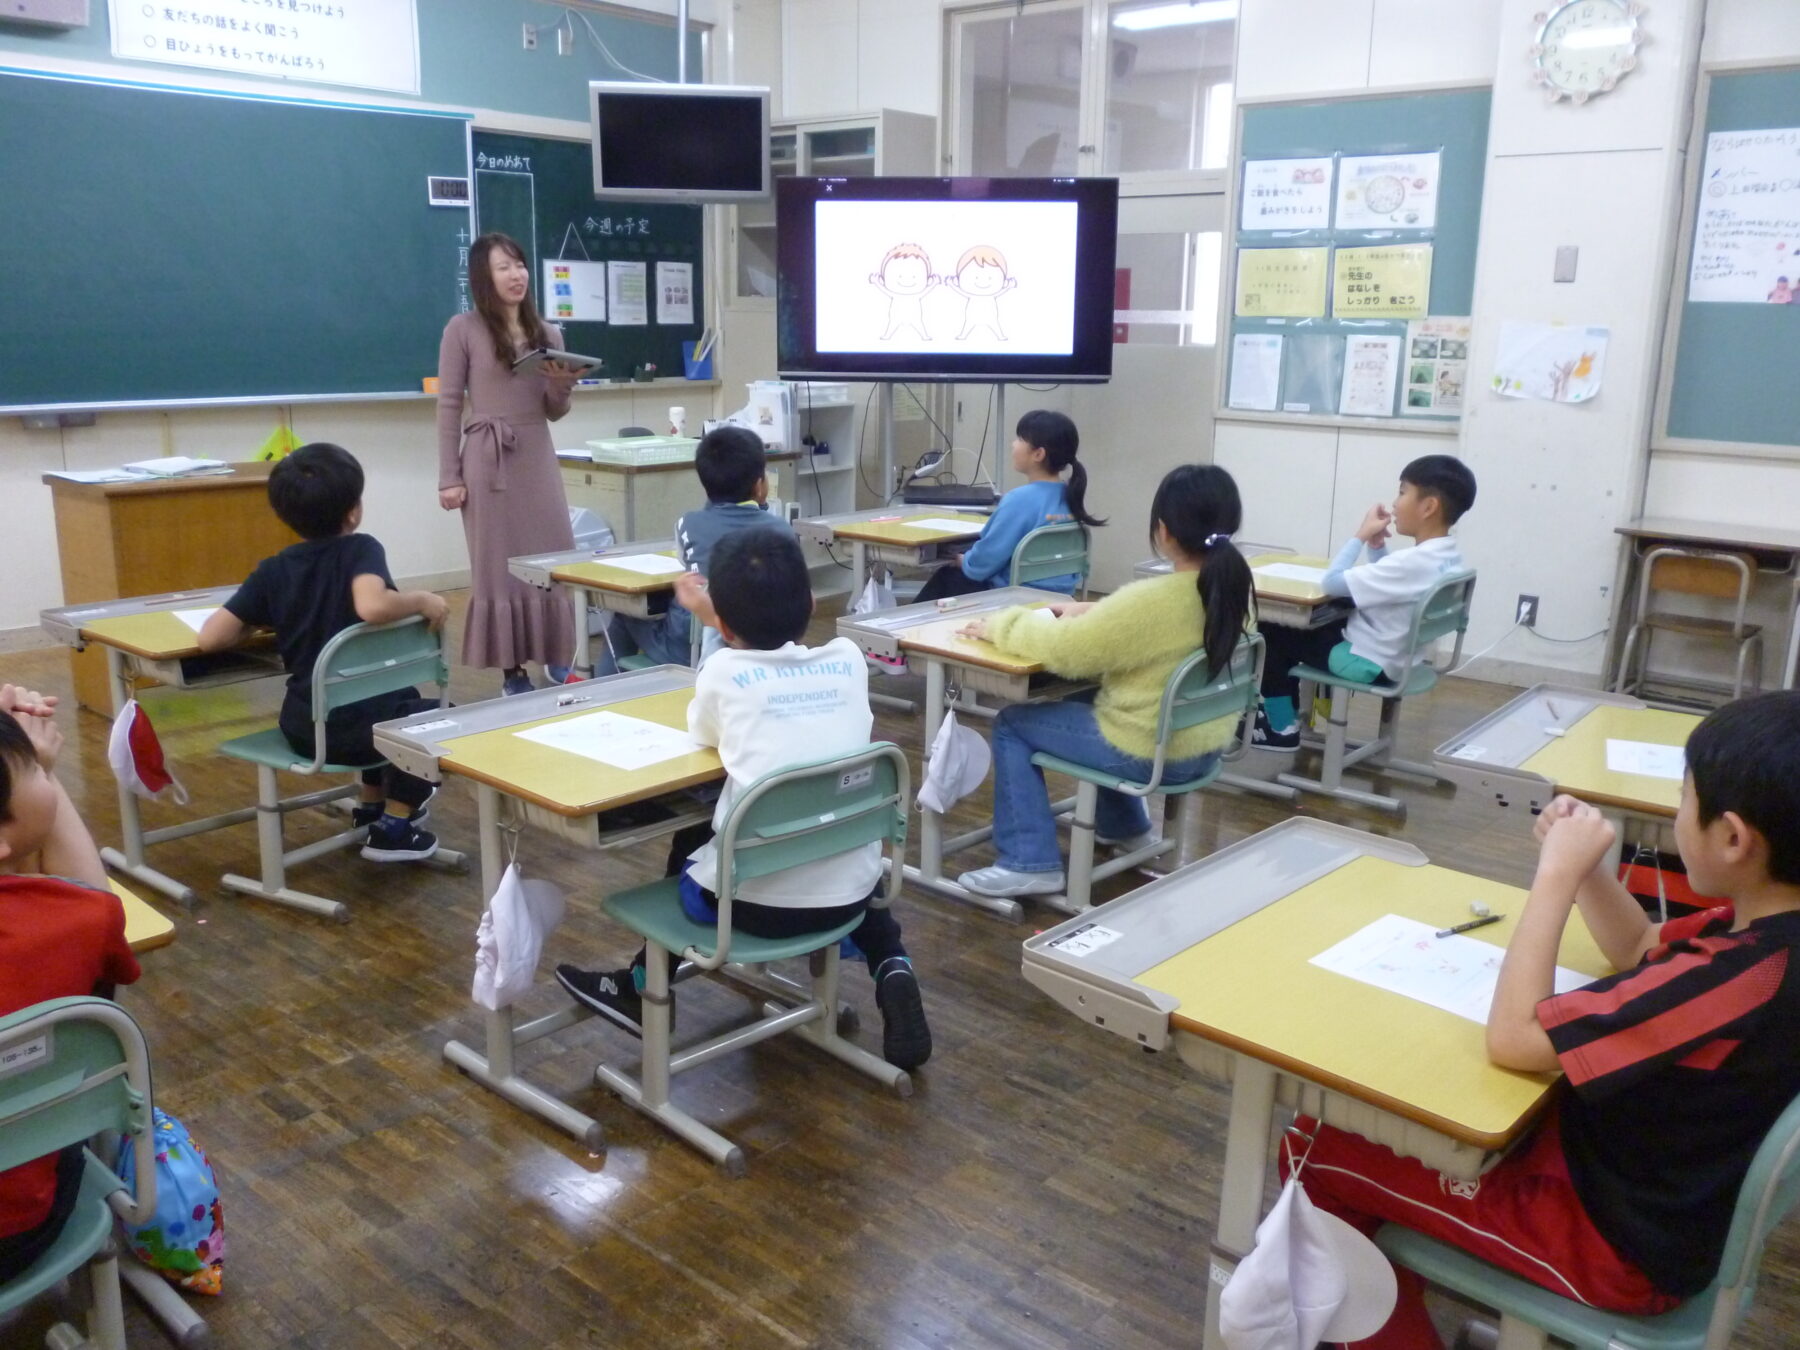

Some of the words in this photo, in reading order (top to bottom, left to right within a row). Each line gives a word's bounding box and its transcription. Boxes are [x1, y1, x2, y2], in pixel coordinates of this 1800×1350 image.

[163, 8, 299, 39] 友だちの話をよく聞こう
[166, 37, 325, 70] 目ひょうをもってがんばろう
[476, 151, 531, 170] 今日のめあて
[584, 216, 650, 235] 今週の予定
[775, 662, 853, 678] KITCHEN
[767, 688, 839, 705] INDEPENDENT
